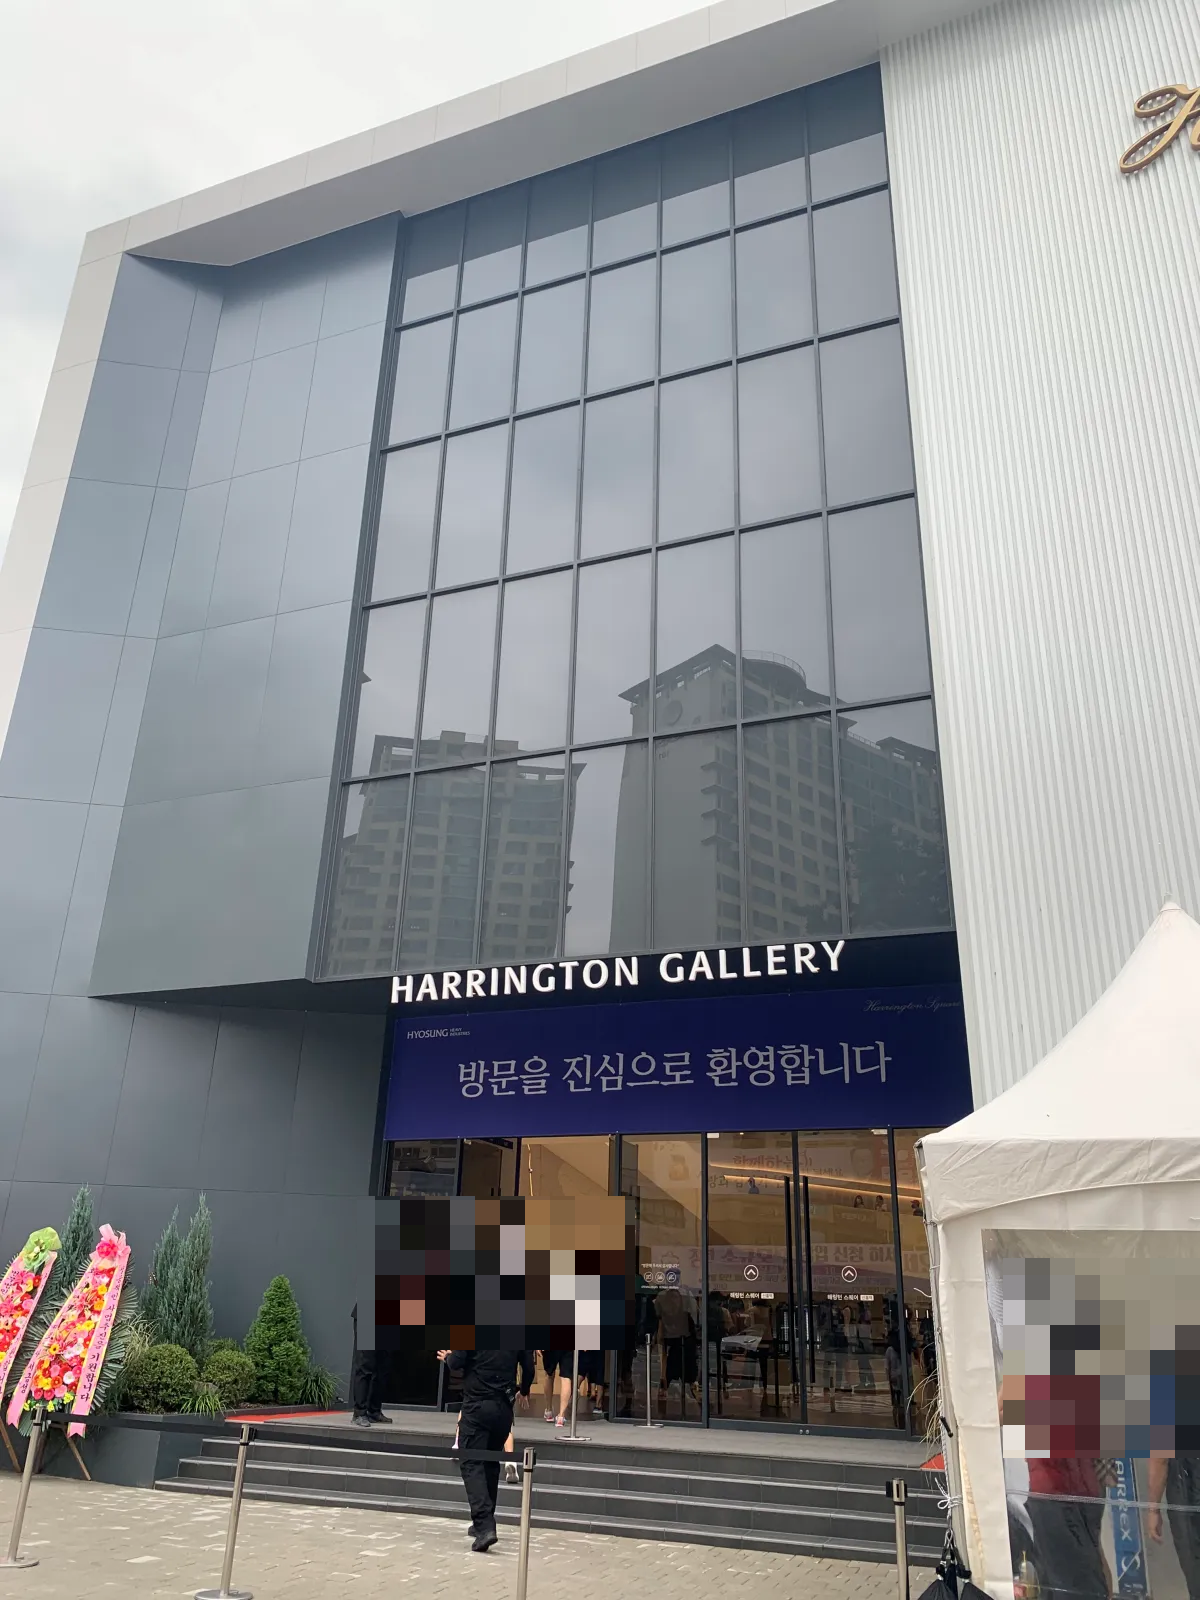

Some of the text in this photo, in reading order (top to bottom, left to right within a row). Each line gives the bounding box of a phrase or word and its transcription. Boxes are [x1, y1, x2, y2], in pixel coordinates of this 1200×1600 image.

[391, 940, 846, 1004] HARRINGTON GALLERY
[407, 1028, 448, 1039] HYOSUNG
[458, 1040, 892, 1098] 방문을 진심으로 환영합니다
[80, 1353, 101, 1401] 기원합니다
